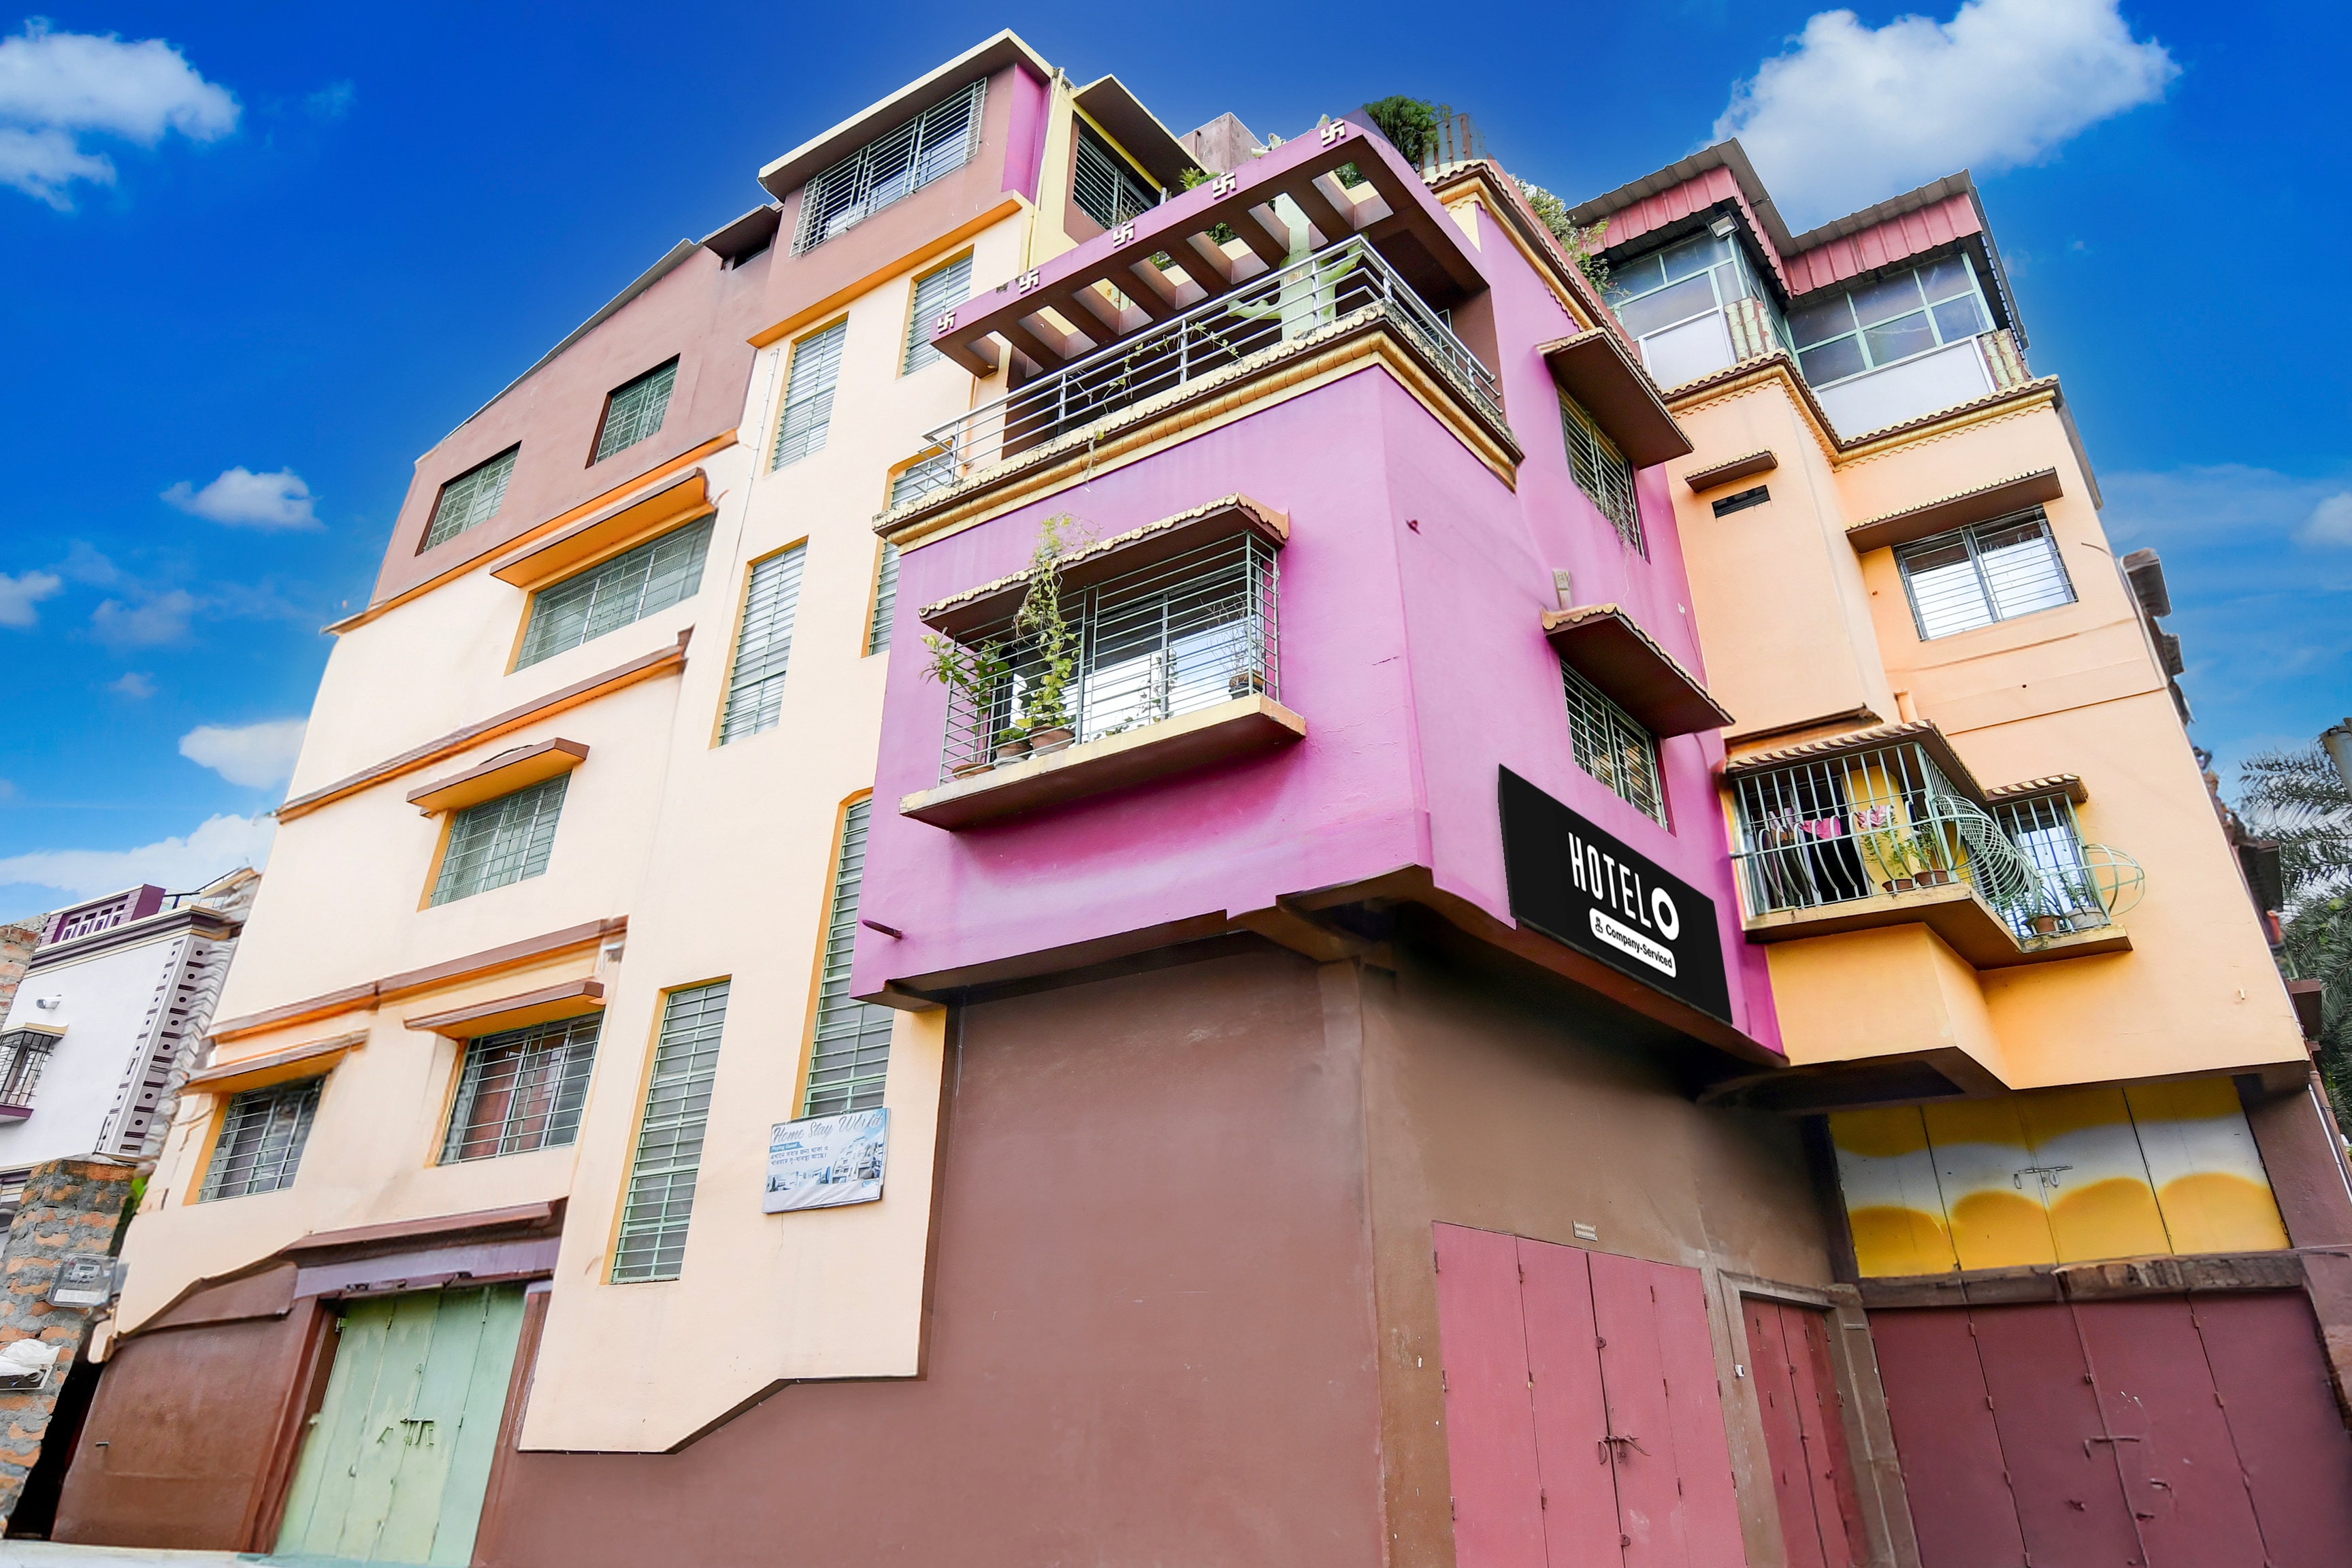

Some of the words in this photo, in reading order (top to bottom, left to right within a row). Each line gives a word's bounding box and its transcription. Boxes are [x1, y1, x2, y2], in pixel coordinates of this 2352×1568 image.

[1605, 924, 1673, 968] Company-Serviced
[773, 1126, 804, 1144] Home
[808, 1121, 832, 1139] Stay
